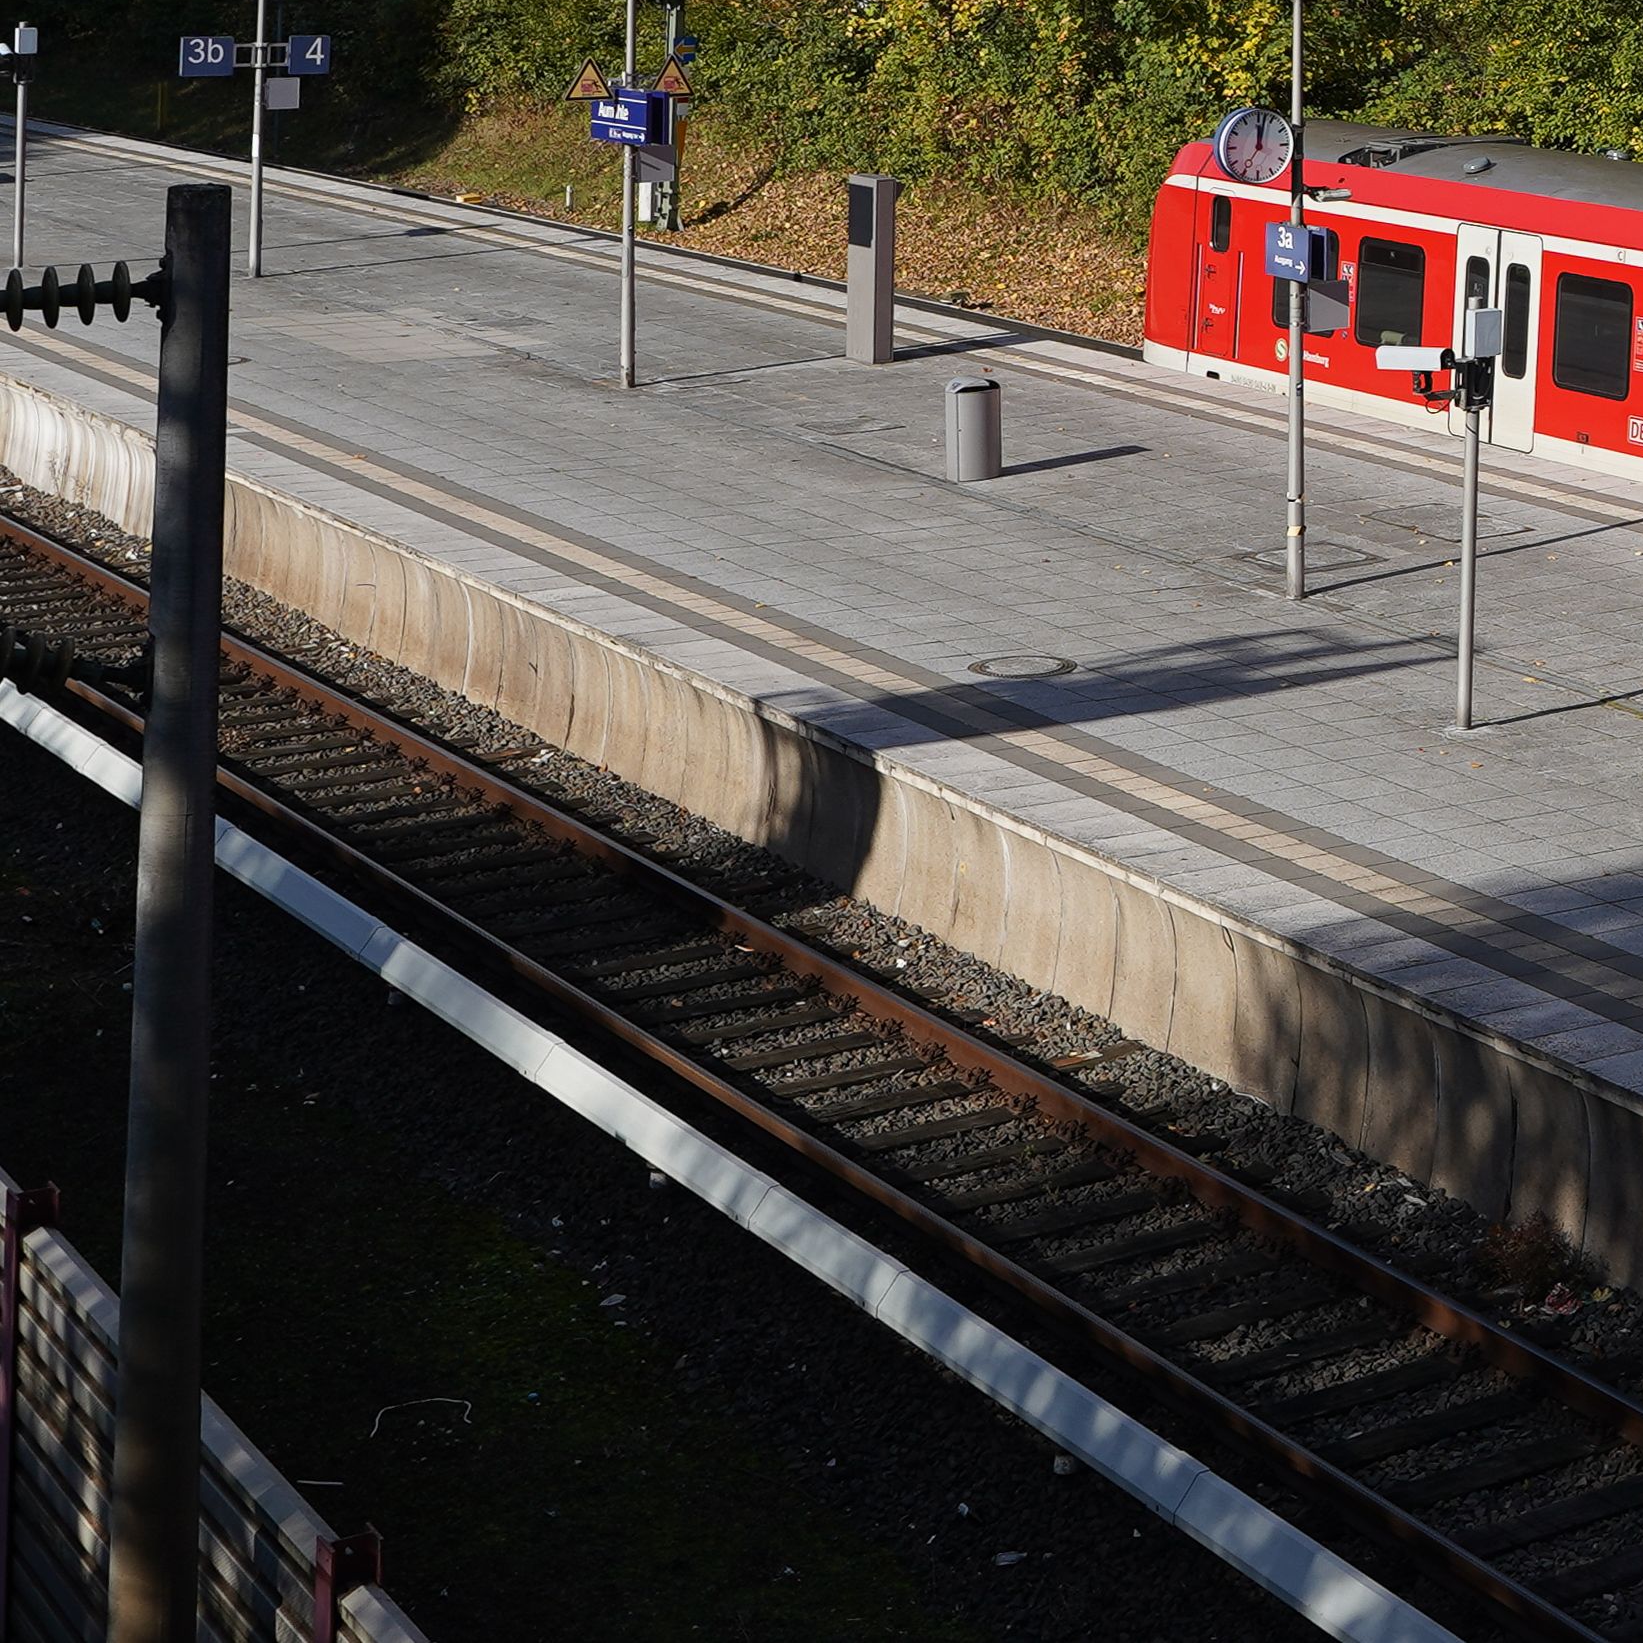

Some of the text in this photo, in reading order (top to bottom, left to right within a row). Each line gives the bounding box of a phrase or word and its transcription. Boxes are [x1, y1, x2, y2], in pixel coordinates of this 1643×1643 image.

[188, 38, 224, 64] 3b
[305, 37, 325, 65] 4
[1277, 226, 1294, 249] 3a
